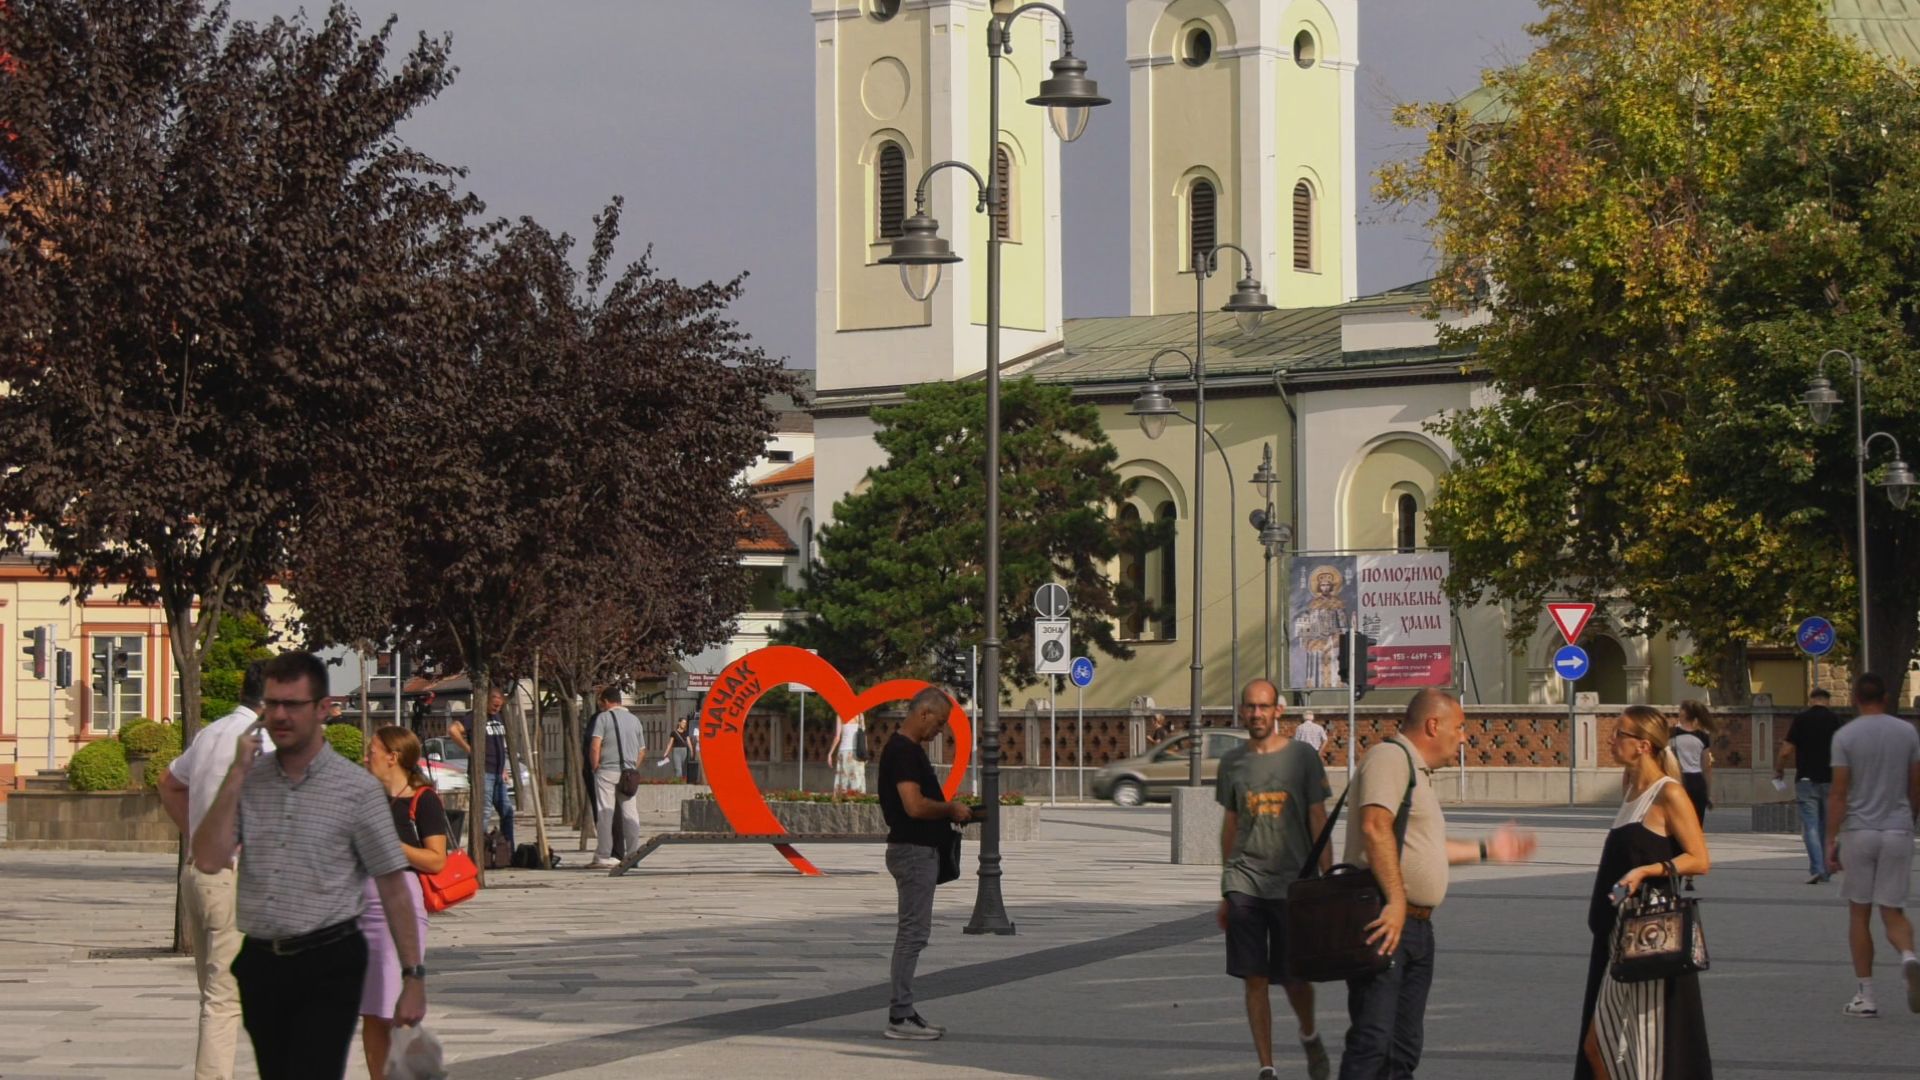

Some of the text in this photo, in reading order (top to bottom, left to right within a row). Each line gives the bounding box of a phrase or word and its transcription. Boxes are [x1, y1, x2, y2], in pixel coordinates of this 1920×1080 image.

[1042, 626, 1064, 634] ЗОНА
[1400, 615, 1442, 637] ХРАМА
[704, 660, 756, 737] ЧАЧАК
